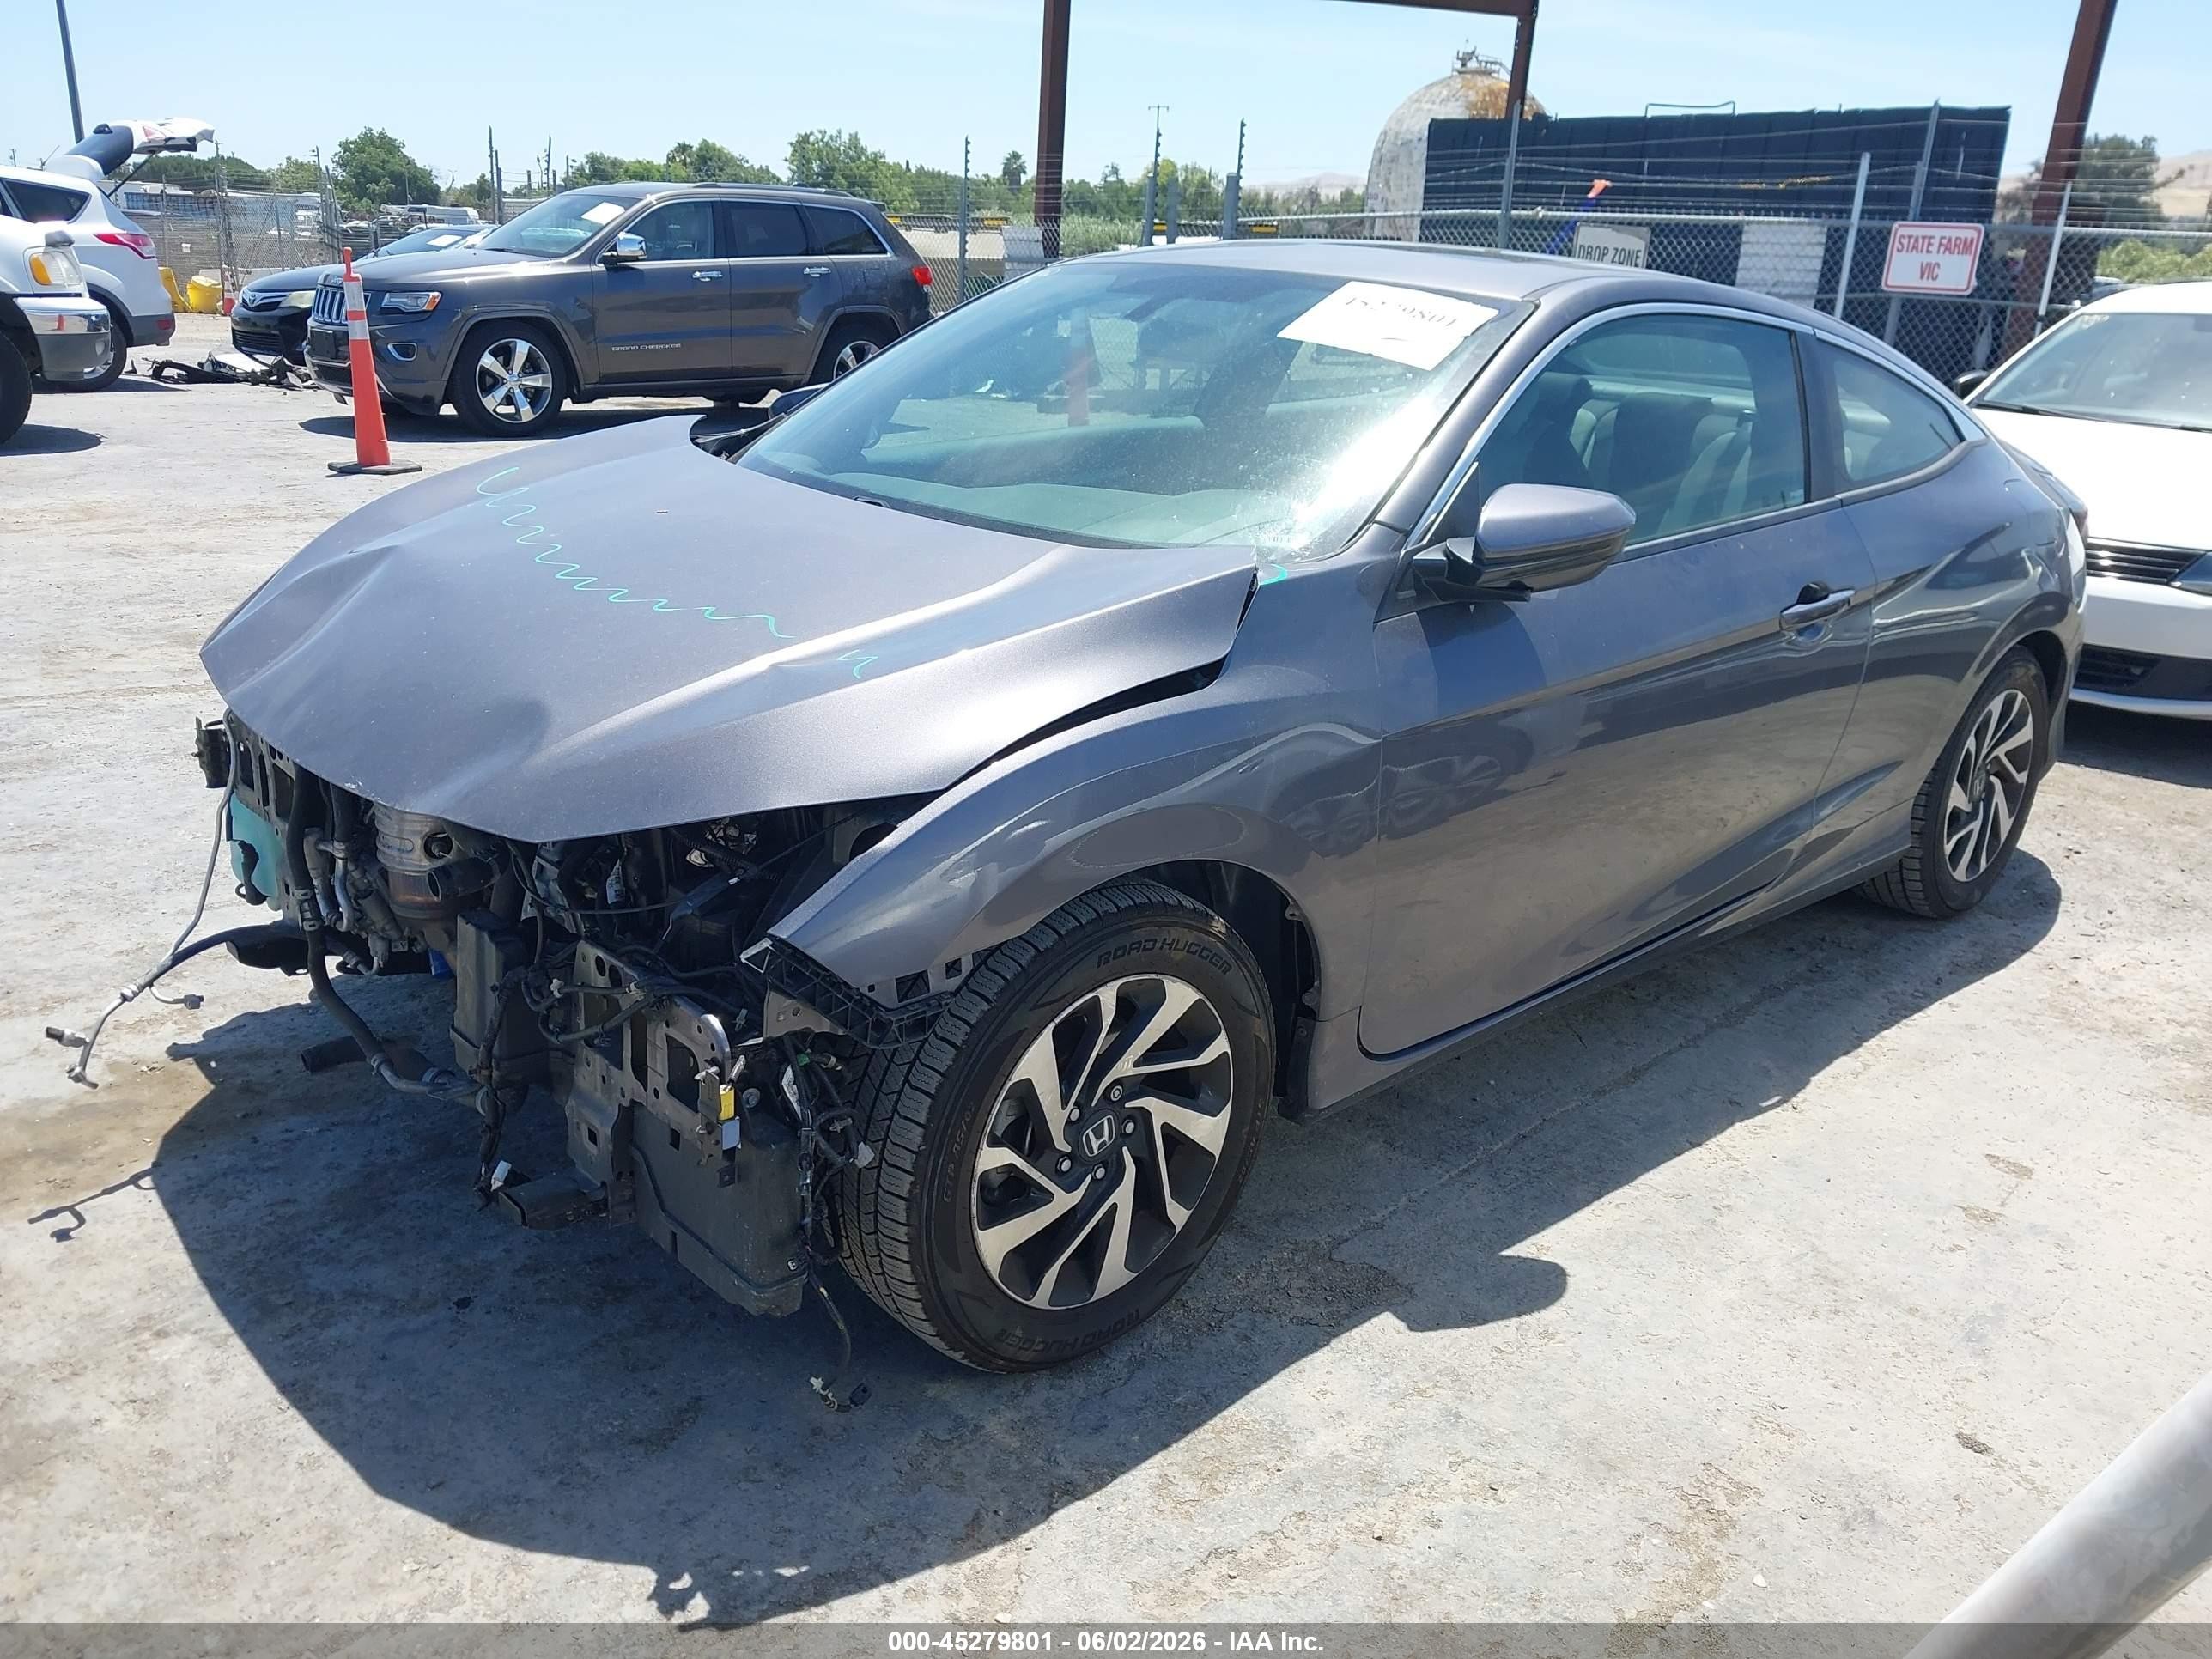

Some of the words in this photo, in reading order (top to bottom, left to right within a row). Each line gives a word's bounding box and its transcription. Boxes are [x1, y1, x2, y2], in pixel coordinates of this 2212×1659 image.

[1896, 234, 1936, 253] STATE
[1936, 236, 1975, 255] FARM
[1577, 245, 1609, 261] DROP
[1611, 247, 1642, 267] ZONE
[1919, 261, 1941, 281] VIC
[1097, 938, 1158, 969] ROAD
[1159, 938, 1232, 975] HUGGER
